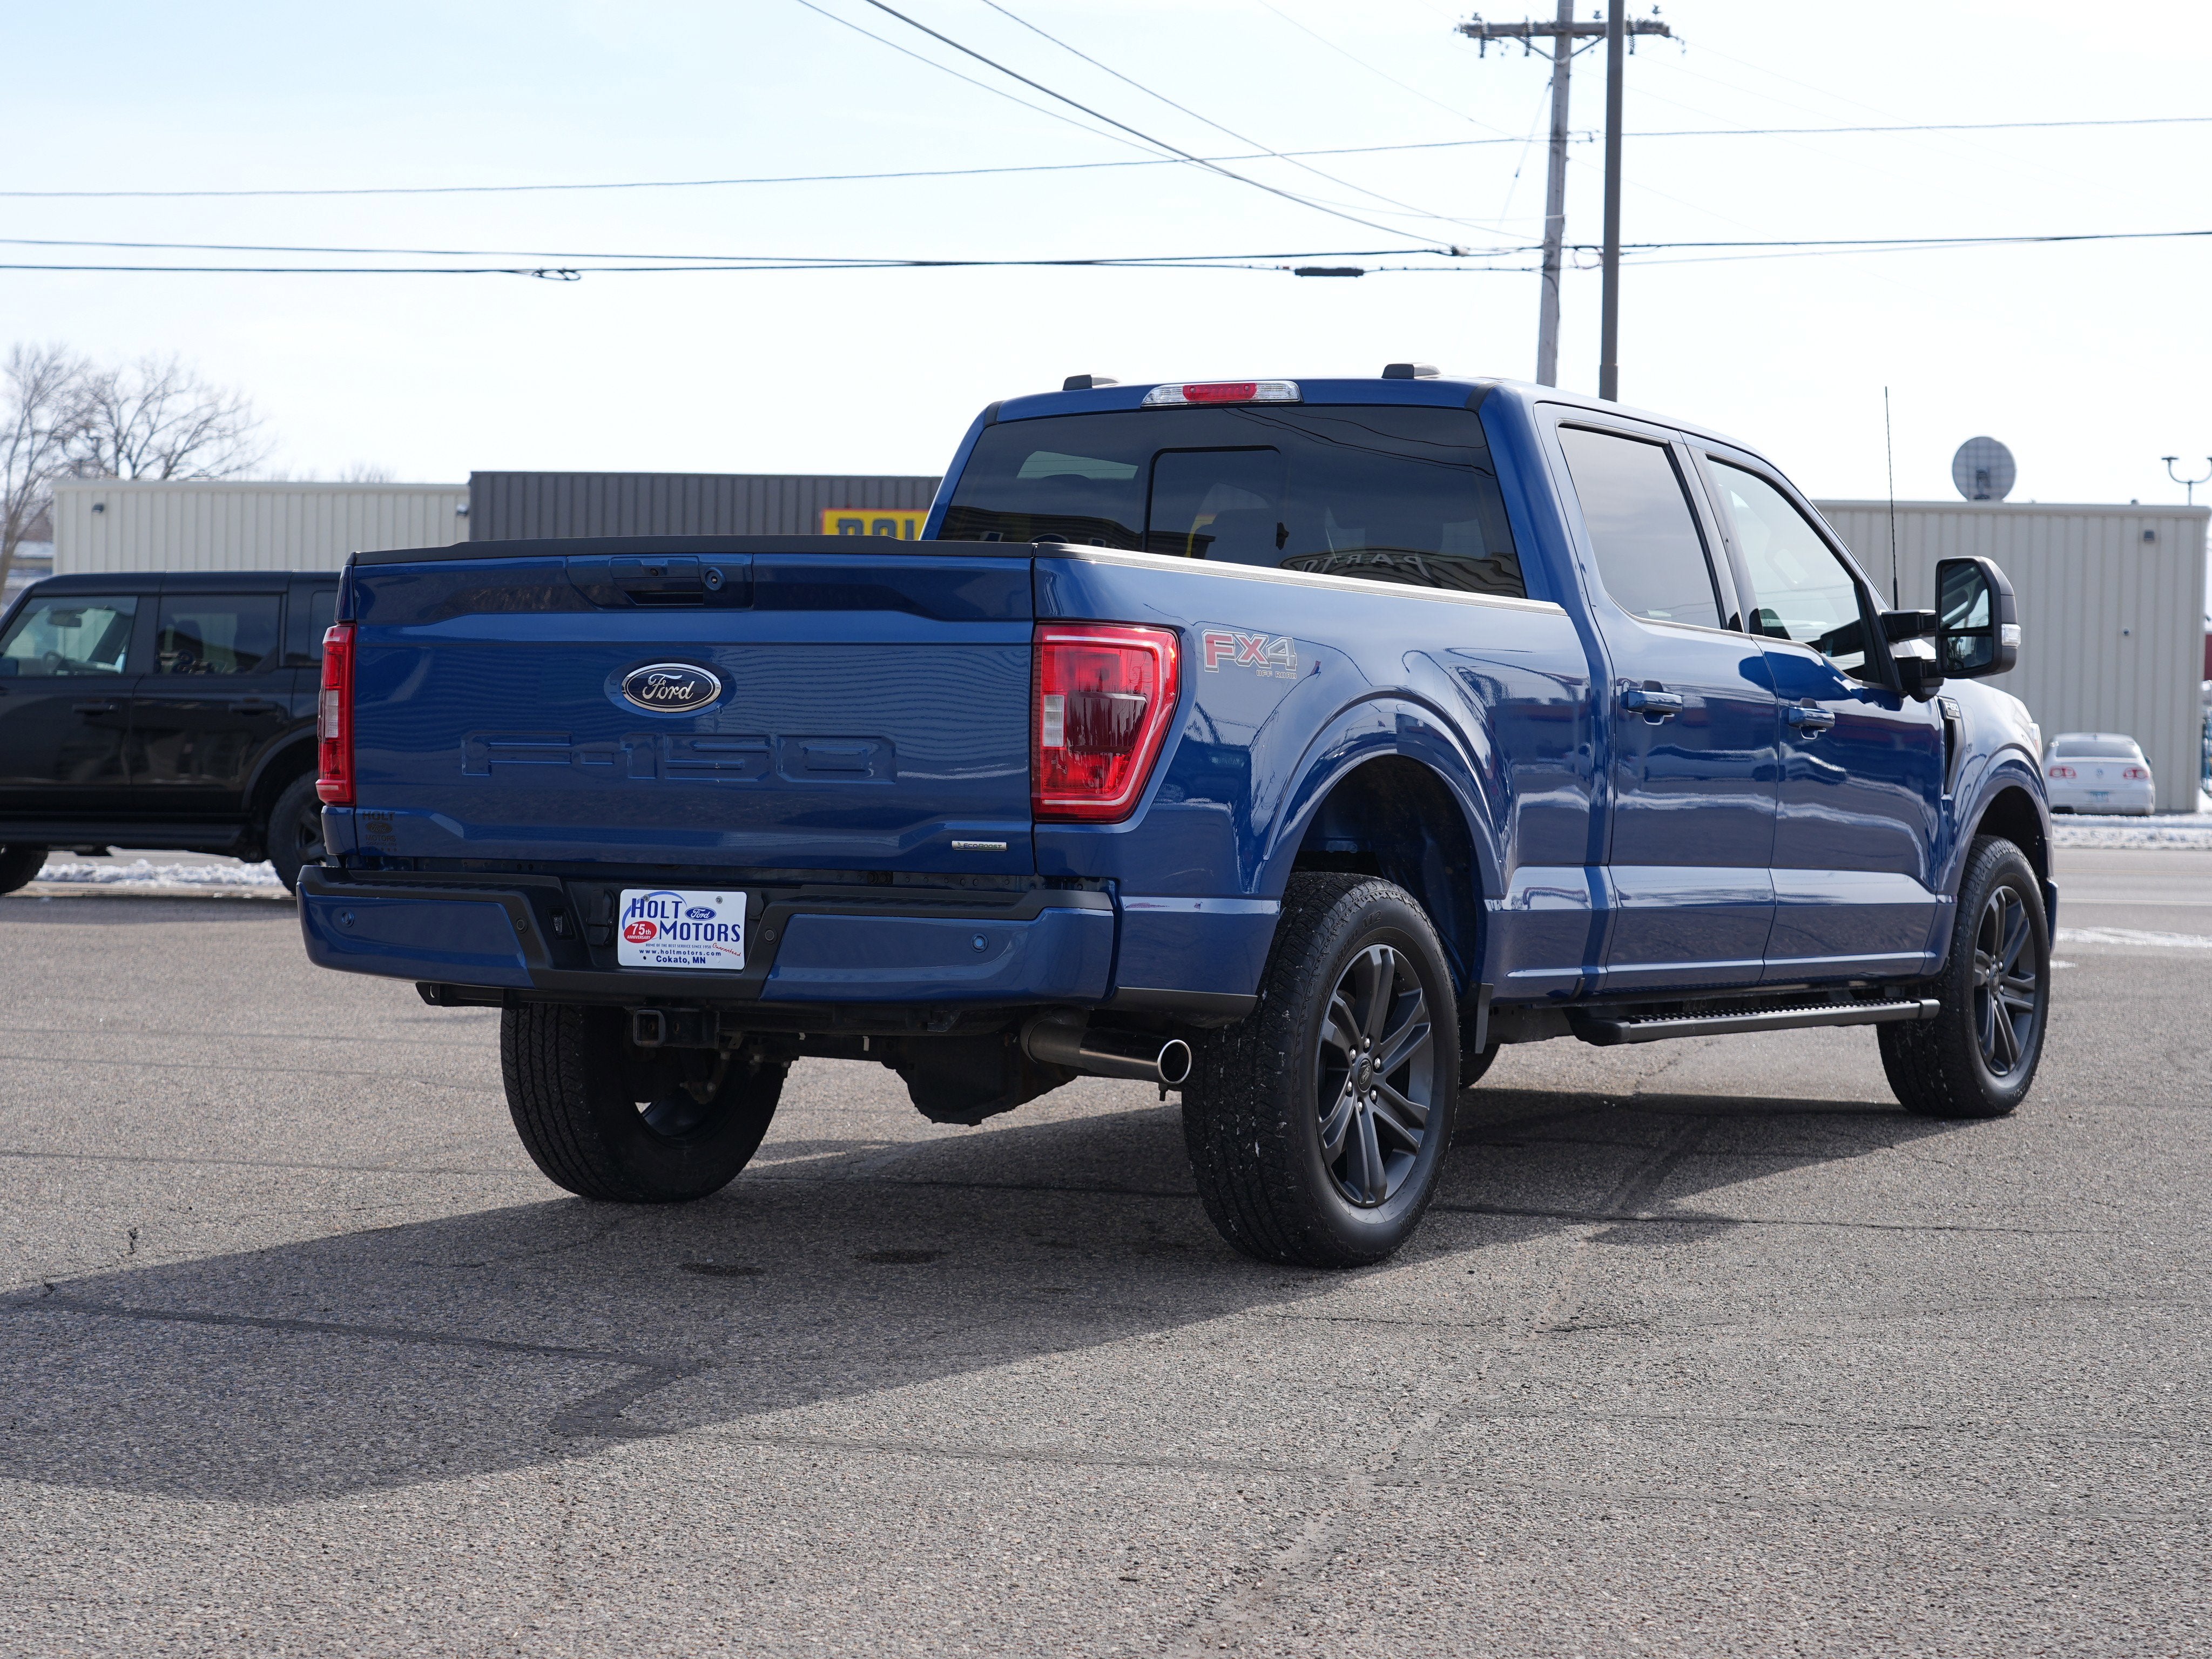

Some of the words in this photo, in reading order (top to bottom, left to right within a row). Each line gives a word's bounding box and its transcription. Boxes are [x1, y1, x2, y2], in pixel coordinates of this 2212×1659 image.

[1202, 629, 1297, 672] FX4
[1275, 671, 1297, 679] ROAD
[642, 673, 695, 700] Ford
[461, 730, 896, 785] F-150
[362, 811, 396, 821] HOLT
[631, 898, 682, 919] HOLT
[690, 908, 710, 919] Ford
[632, 923, 651, 936] 75th
[659, 920, 741, 942] MOTORS
[712, 942, 742, 956] Guaranteed
[656, 955, 690, 965] Cokato,
